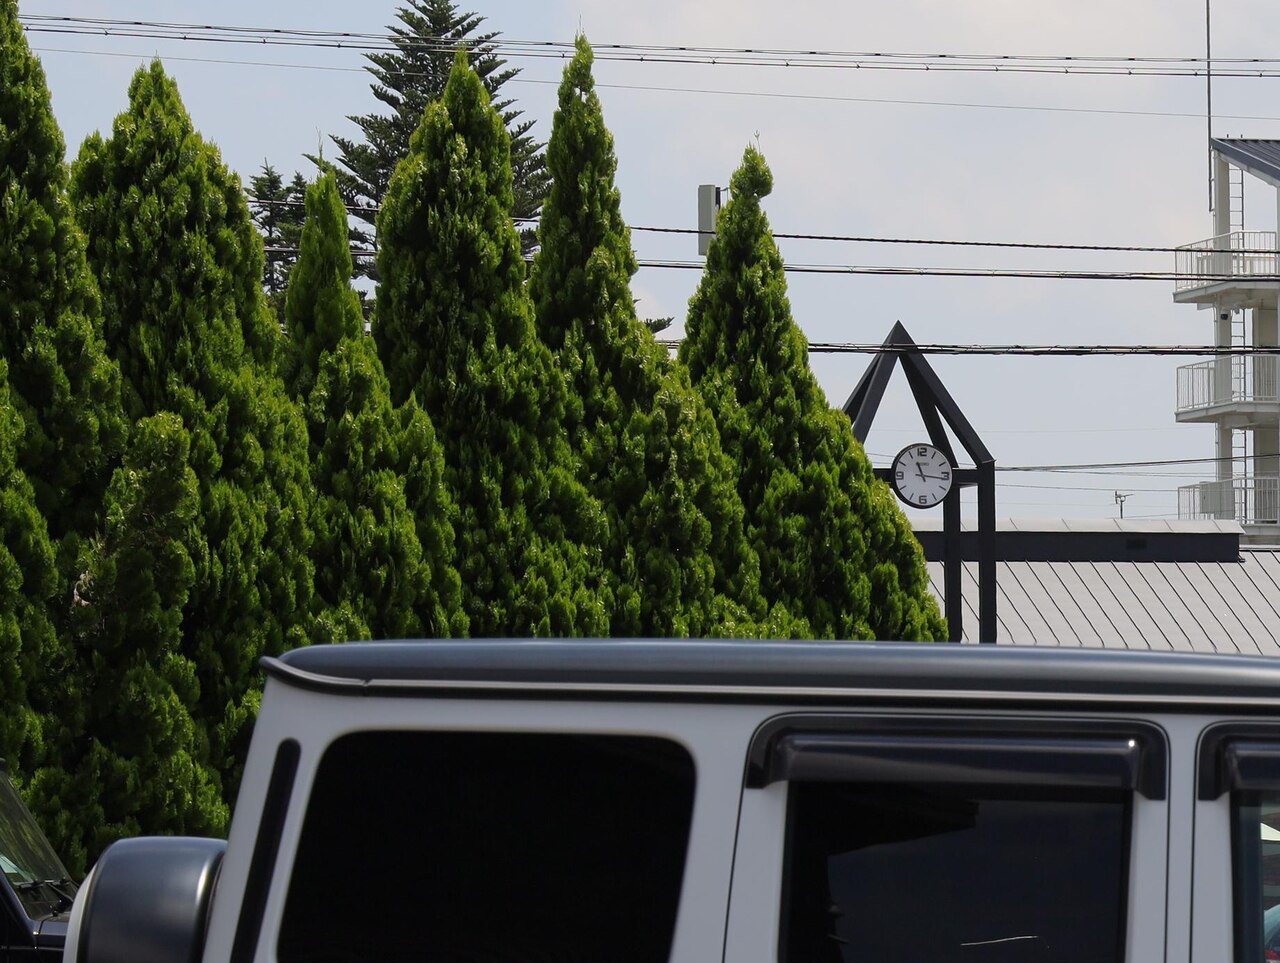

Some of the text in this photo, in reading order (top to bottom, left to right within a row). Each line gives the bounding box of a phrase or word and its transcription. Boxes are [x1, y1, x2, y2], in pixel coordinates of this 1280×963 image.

[917, 447, 927, 457] 12
[895, 471, 904, 480] 9
[941, 471, 950, 480] 3
[918, 495, 927, 504] 6
